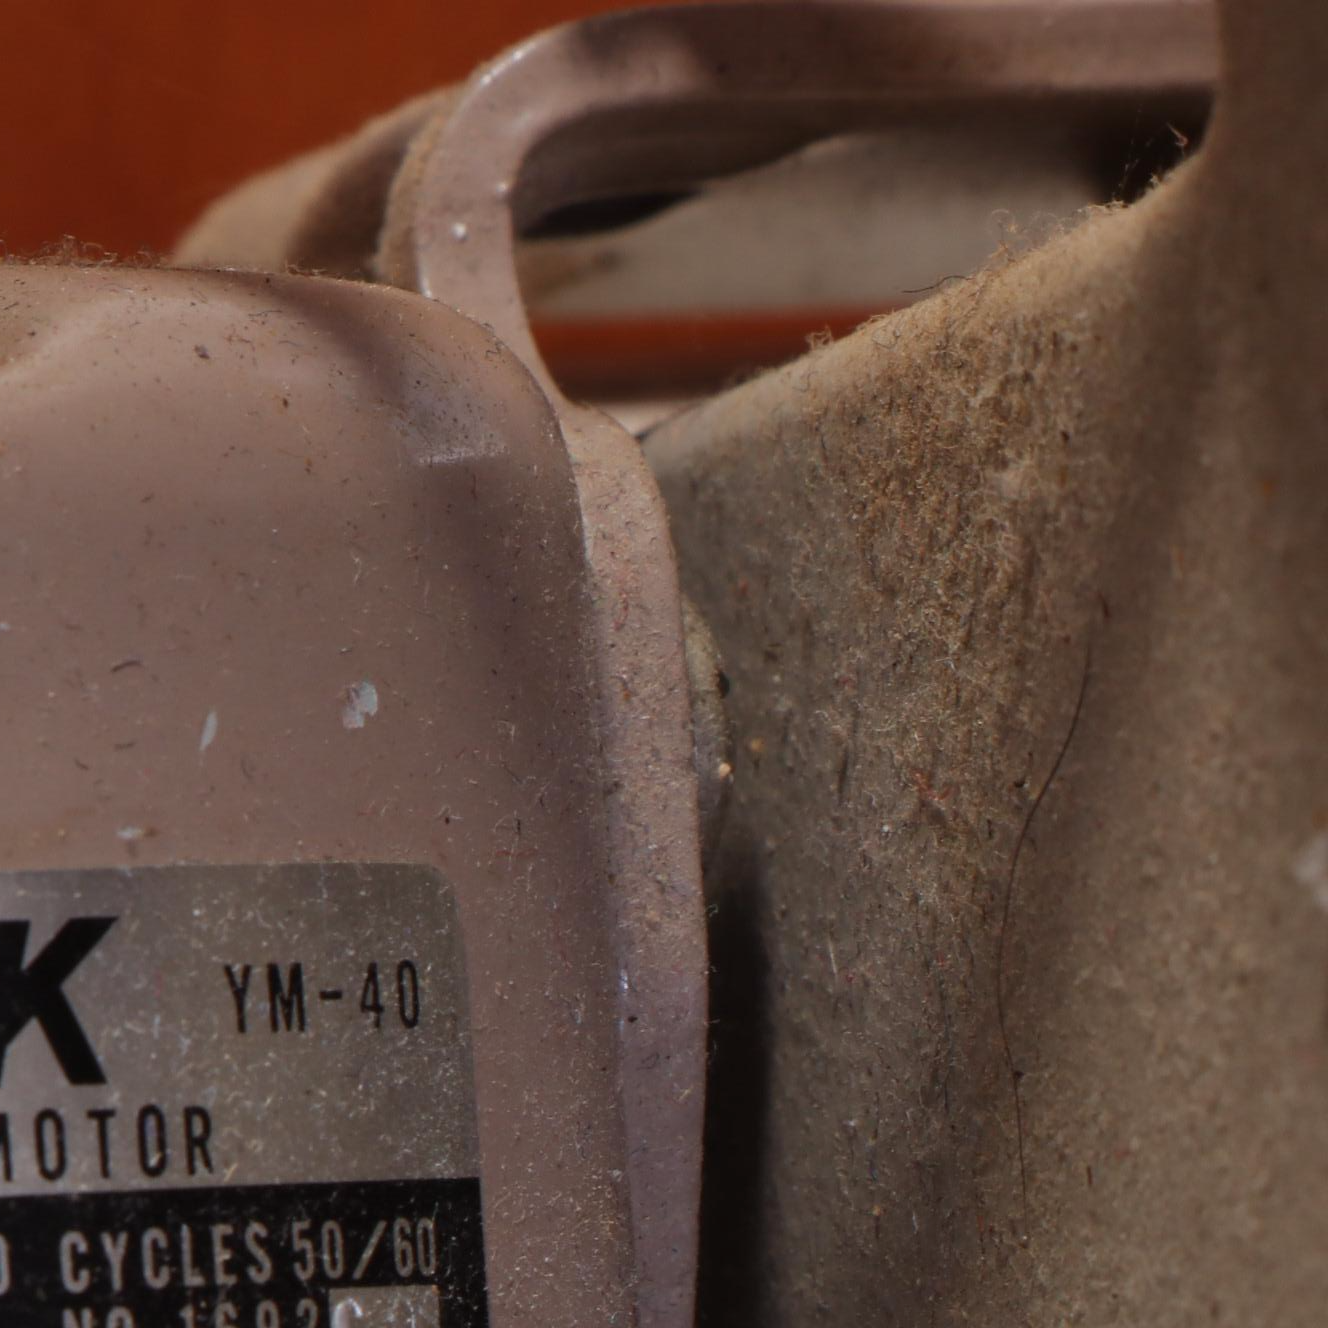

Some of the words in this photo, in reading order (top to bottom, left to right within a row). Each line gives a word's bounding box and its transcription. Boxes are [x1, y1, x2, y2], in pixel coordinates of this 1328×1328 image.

[223, 957, 422, 1034] YM-40
[59, 1220, 273, 1294] CYCLES
[292, 1216, 438, 1280] 50/60
